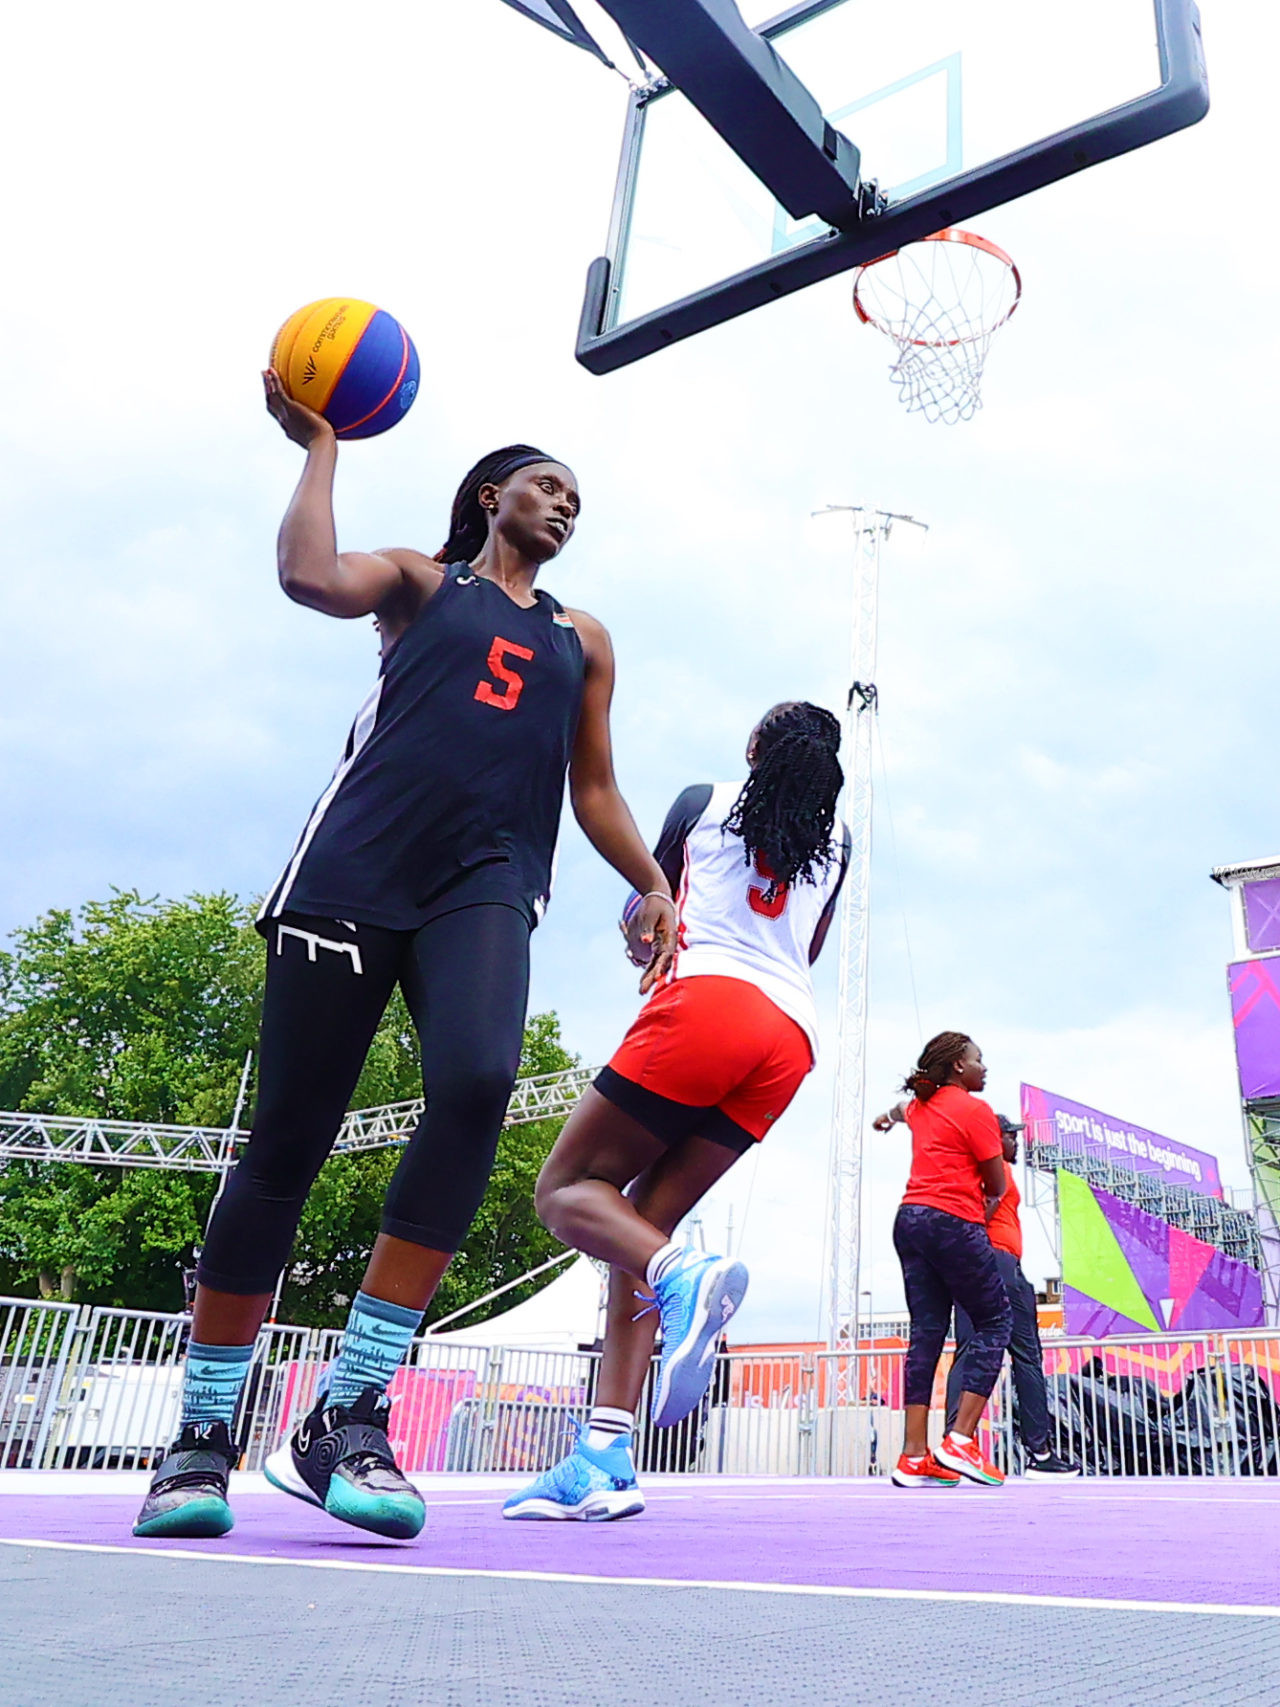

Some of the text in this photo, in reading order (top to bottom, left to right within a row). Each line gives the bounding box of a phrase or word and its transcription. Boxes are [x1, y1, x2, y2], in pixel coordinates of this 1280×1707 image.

[473, 636, 535, 711] 5
[1055, 1110, 1202, 1182] sport is just the beginning
